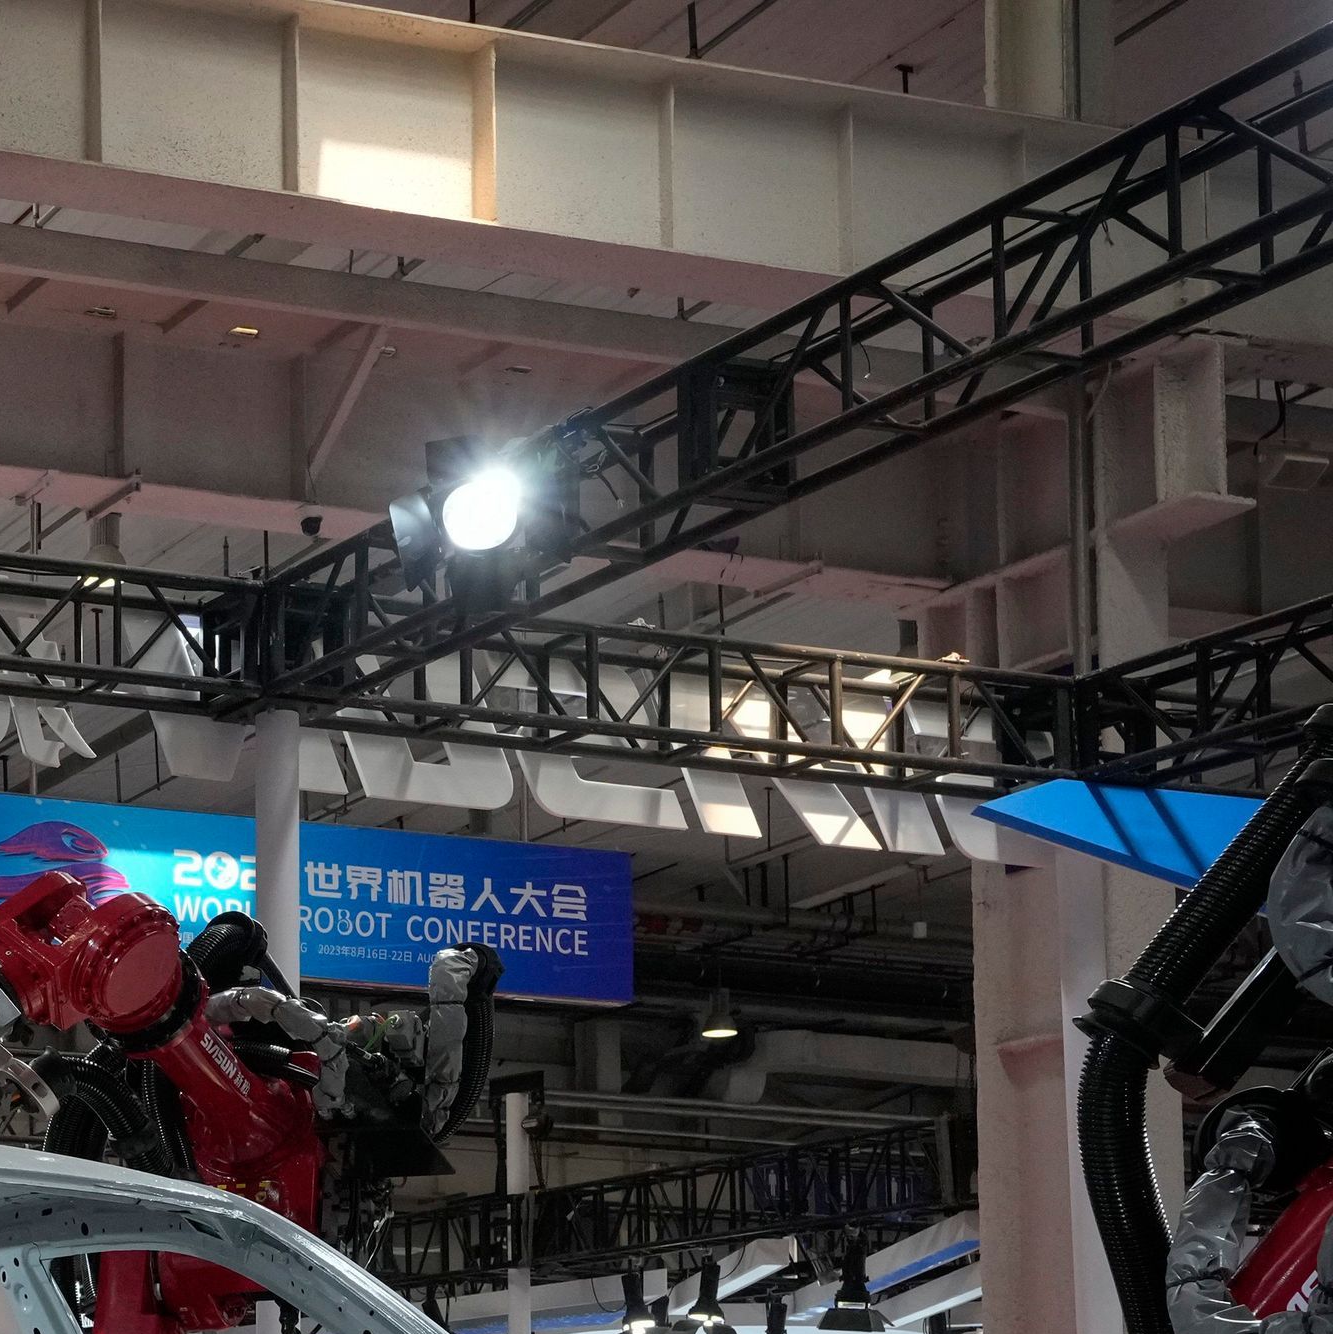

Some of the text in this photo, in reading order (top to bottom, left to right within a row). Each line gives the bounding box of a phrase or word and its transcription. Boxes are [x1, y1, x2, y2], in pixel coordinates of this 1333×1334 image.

[174, 849, 588, 921] 202 世界机器人大会
[298, 905, 392, 938] ROBOT
[406, 915, 588, 956] CONFERENCE
[318, 943, 412, 962] 2023年8月16日-22日
[200, 1032, 237, 1079] SIASUN
